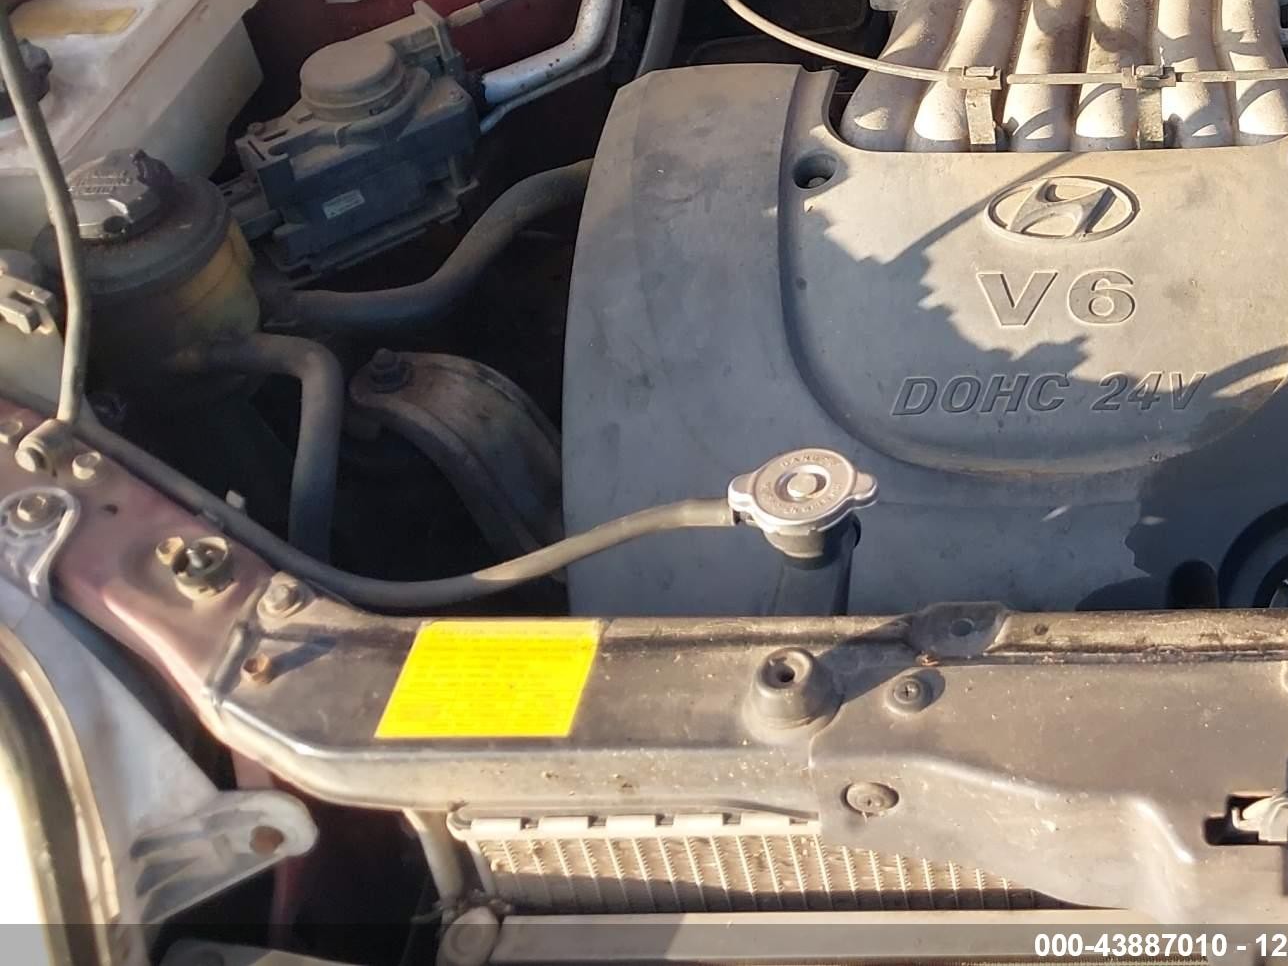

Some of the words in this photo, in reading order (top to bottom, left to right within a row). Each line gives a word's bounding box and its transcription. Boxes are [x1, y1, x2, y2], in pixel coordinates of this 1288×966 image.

[977, 270, 1136, 326] V6
[892, 372, 1071, 417] DOHC
[1091, 370, 1207, 413] 24V
